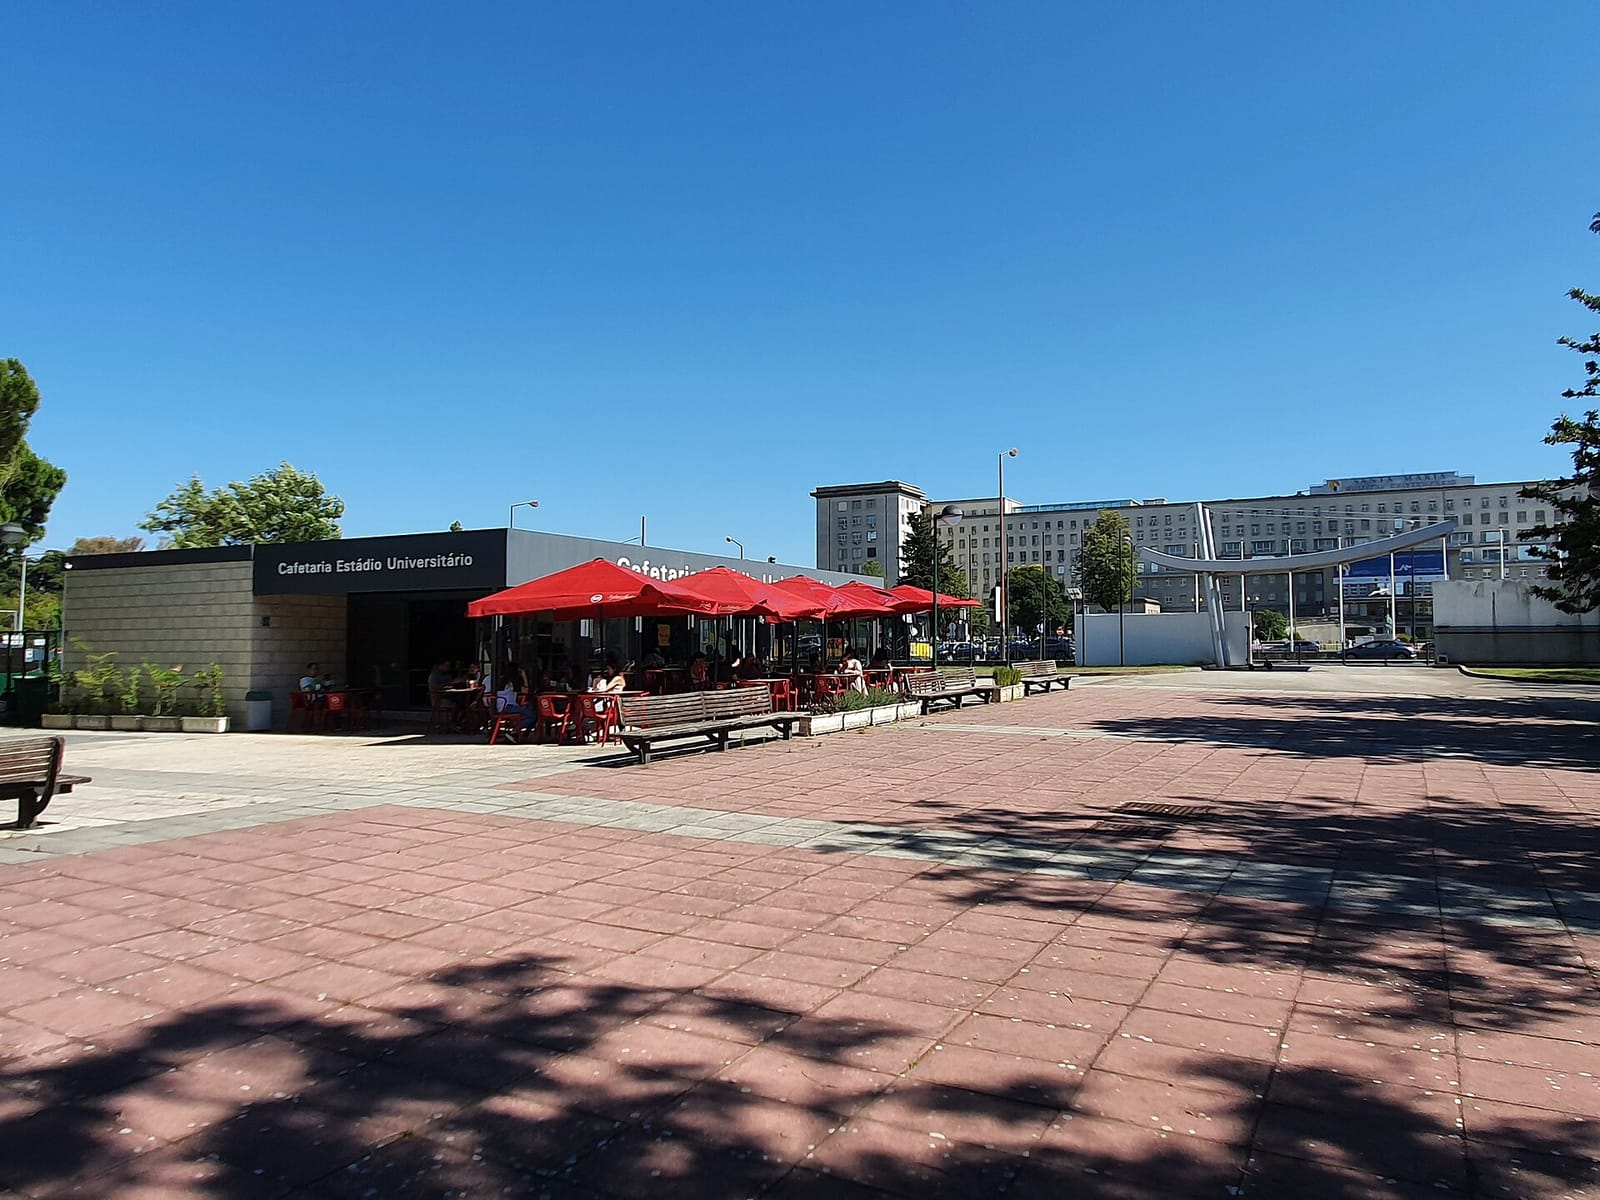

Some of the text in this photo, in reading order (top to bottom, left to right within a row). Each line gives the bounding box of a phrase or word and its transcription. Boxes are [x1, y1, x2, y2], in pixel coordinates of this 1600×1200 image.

[277, 552, 473, 575] Cafetaria Estádio Universitário
[616, 556, 697, 582] Cafetari
